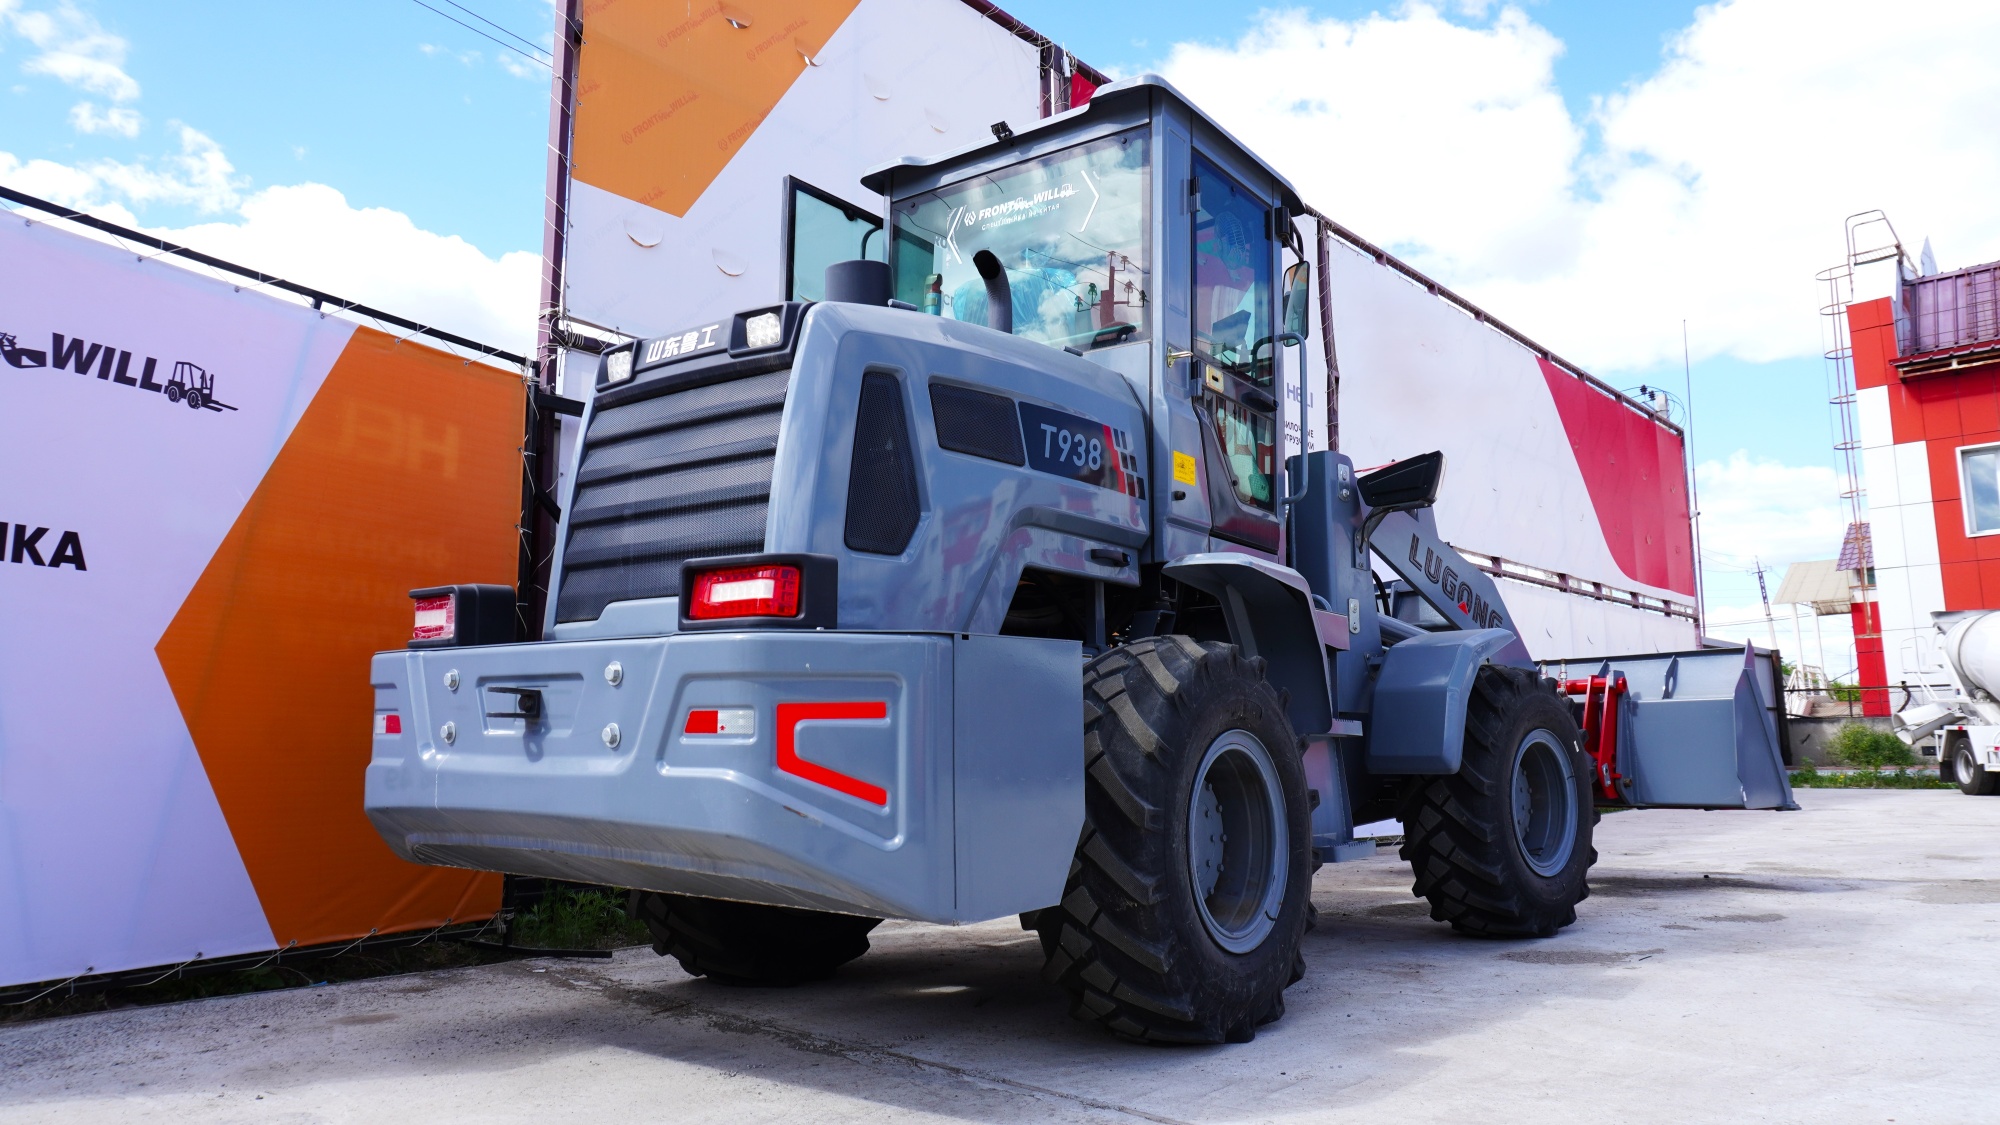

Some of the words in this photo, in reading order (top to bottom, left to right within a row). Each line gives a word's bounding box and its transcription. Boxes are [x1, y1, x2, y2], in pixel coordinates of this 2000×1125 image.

[1033, 189, 1061, 205] WILL
[51, 331, 163, 394] WILL
[646, 324, 720, 364] 山东鲁工
[1286, 381, 1314, 409] HEI
[1040, 422, 1101, 471] T938
